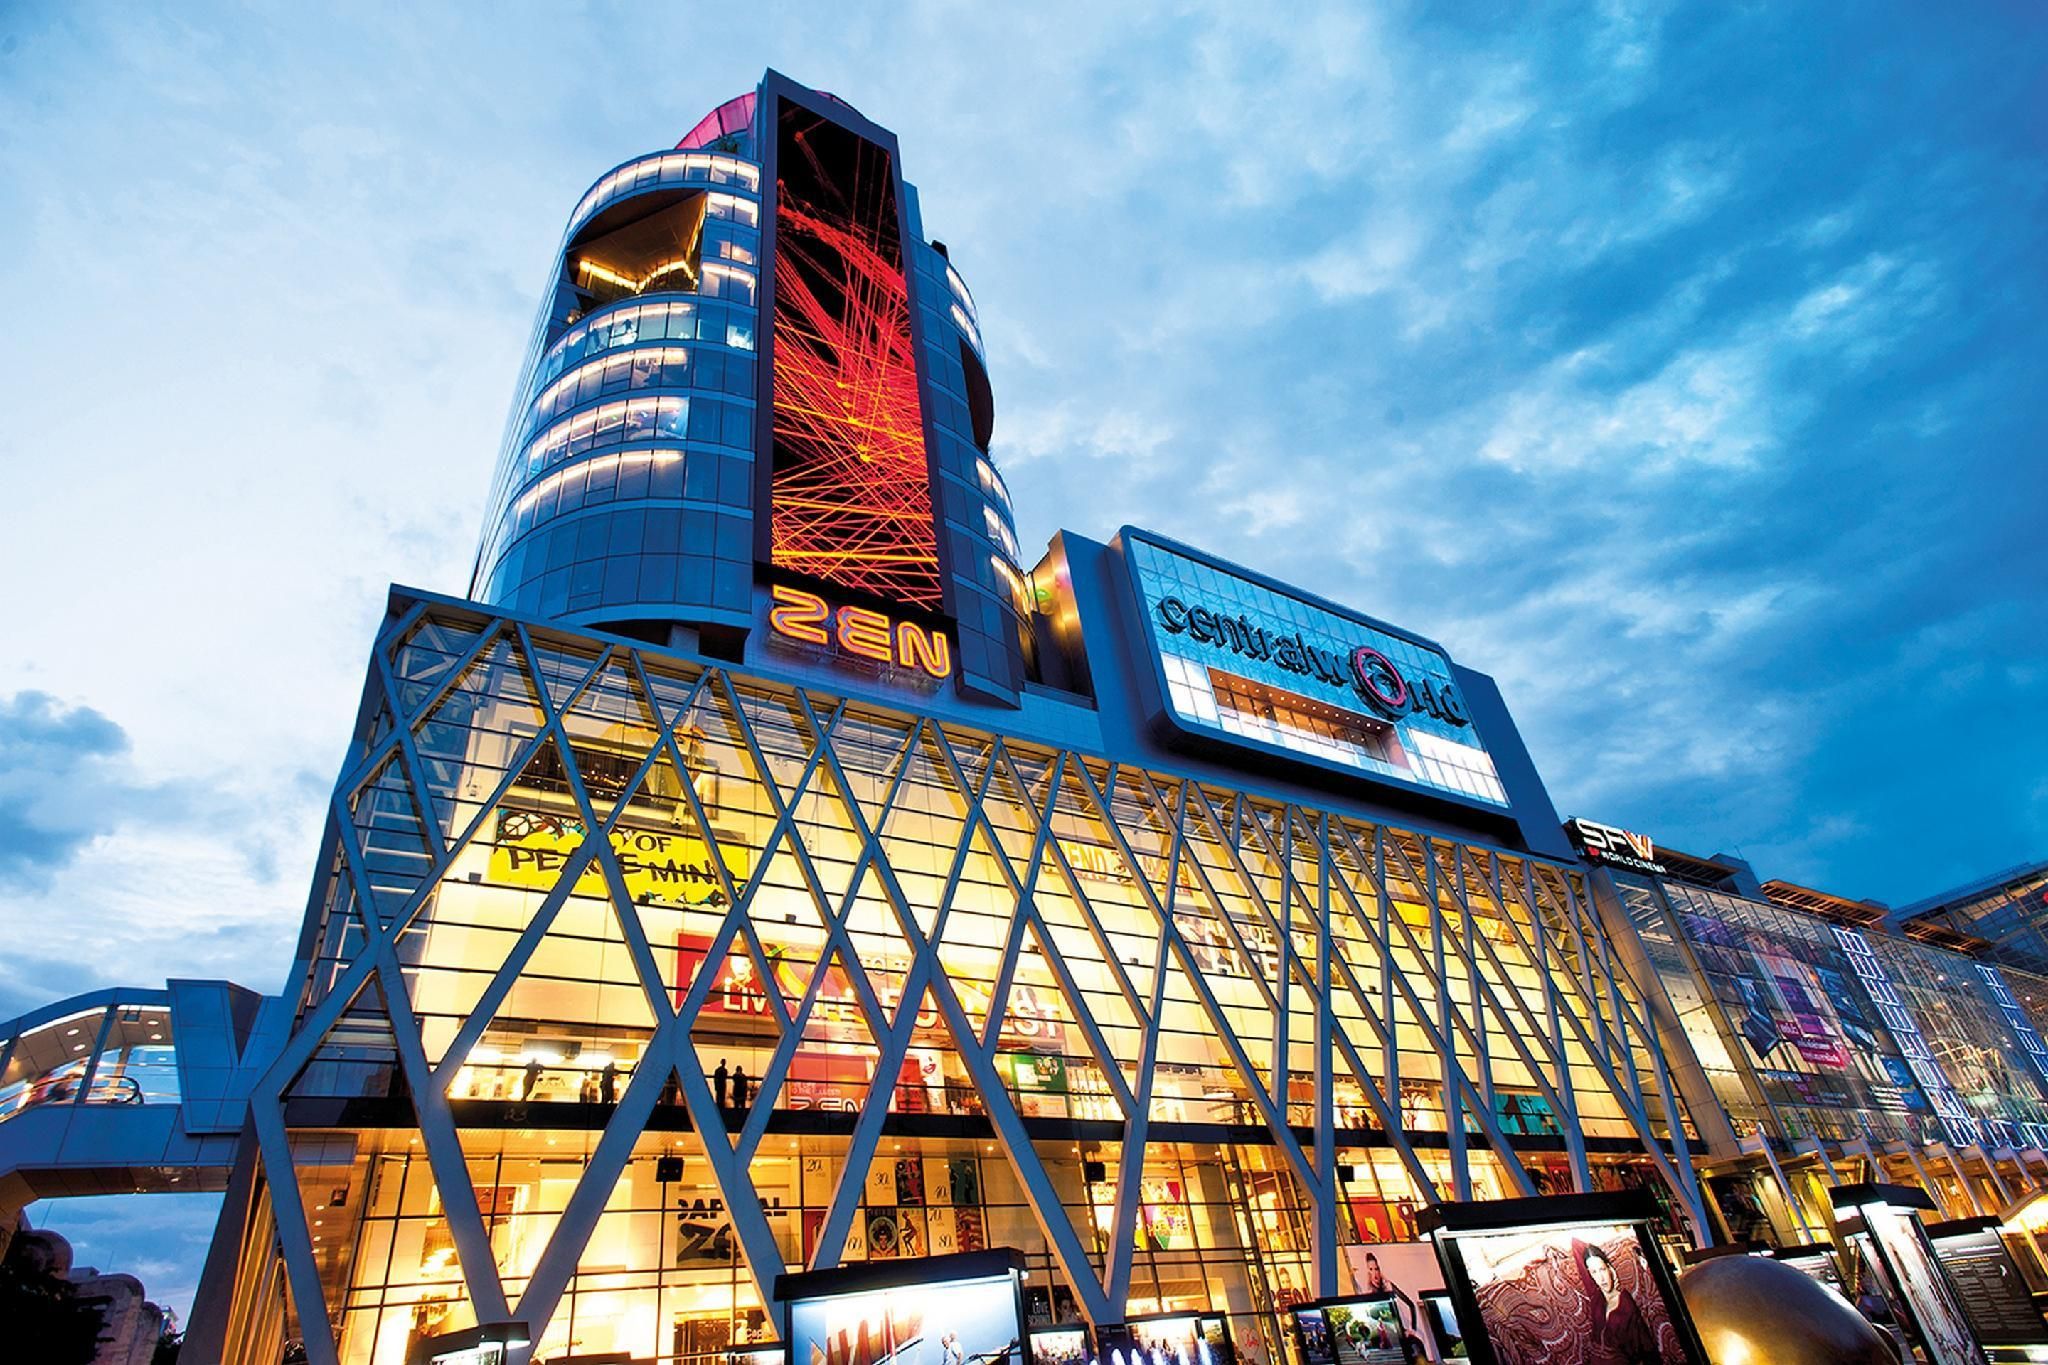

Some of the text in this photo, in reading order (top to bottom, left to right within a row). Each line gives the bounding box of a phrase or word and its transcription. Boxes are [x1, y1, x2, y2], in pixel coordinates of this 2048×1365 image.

[769, 584, 951, 679] ZEN
[635, 834, 672, 853] OF
[1575, 817, 1654, 861] SFW
[507, 846, 642, 876] PEE
[1601, 851, 1633, 866] WORLD
[723, 982, 785, 1013] LIV
